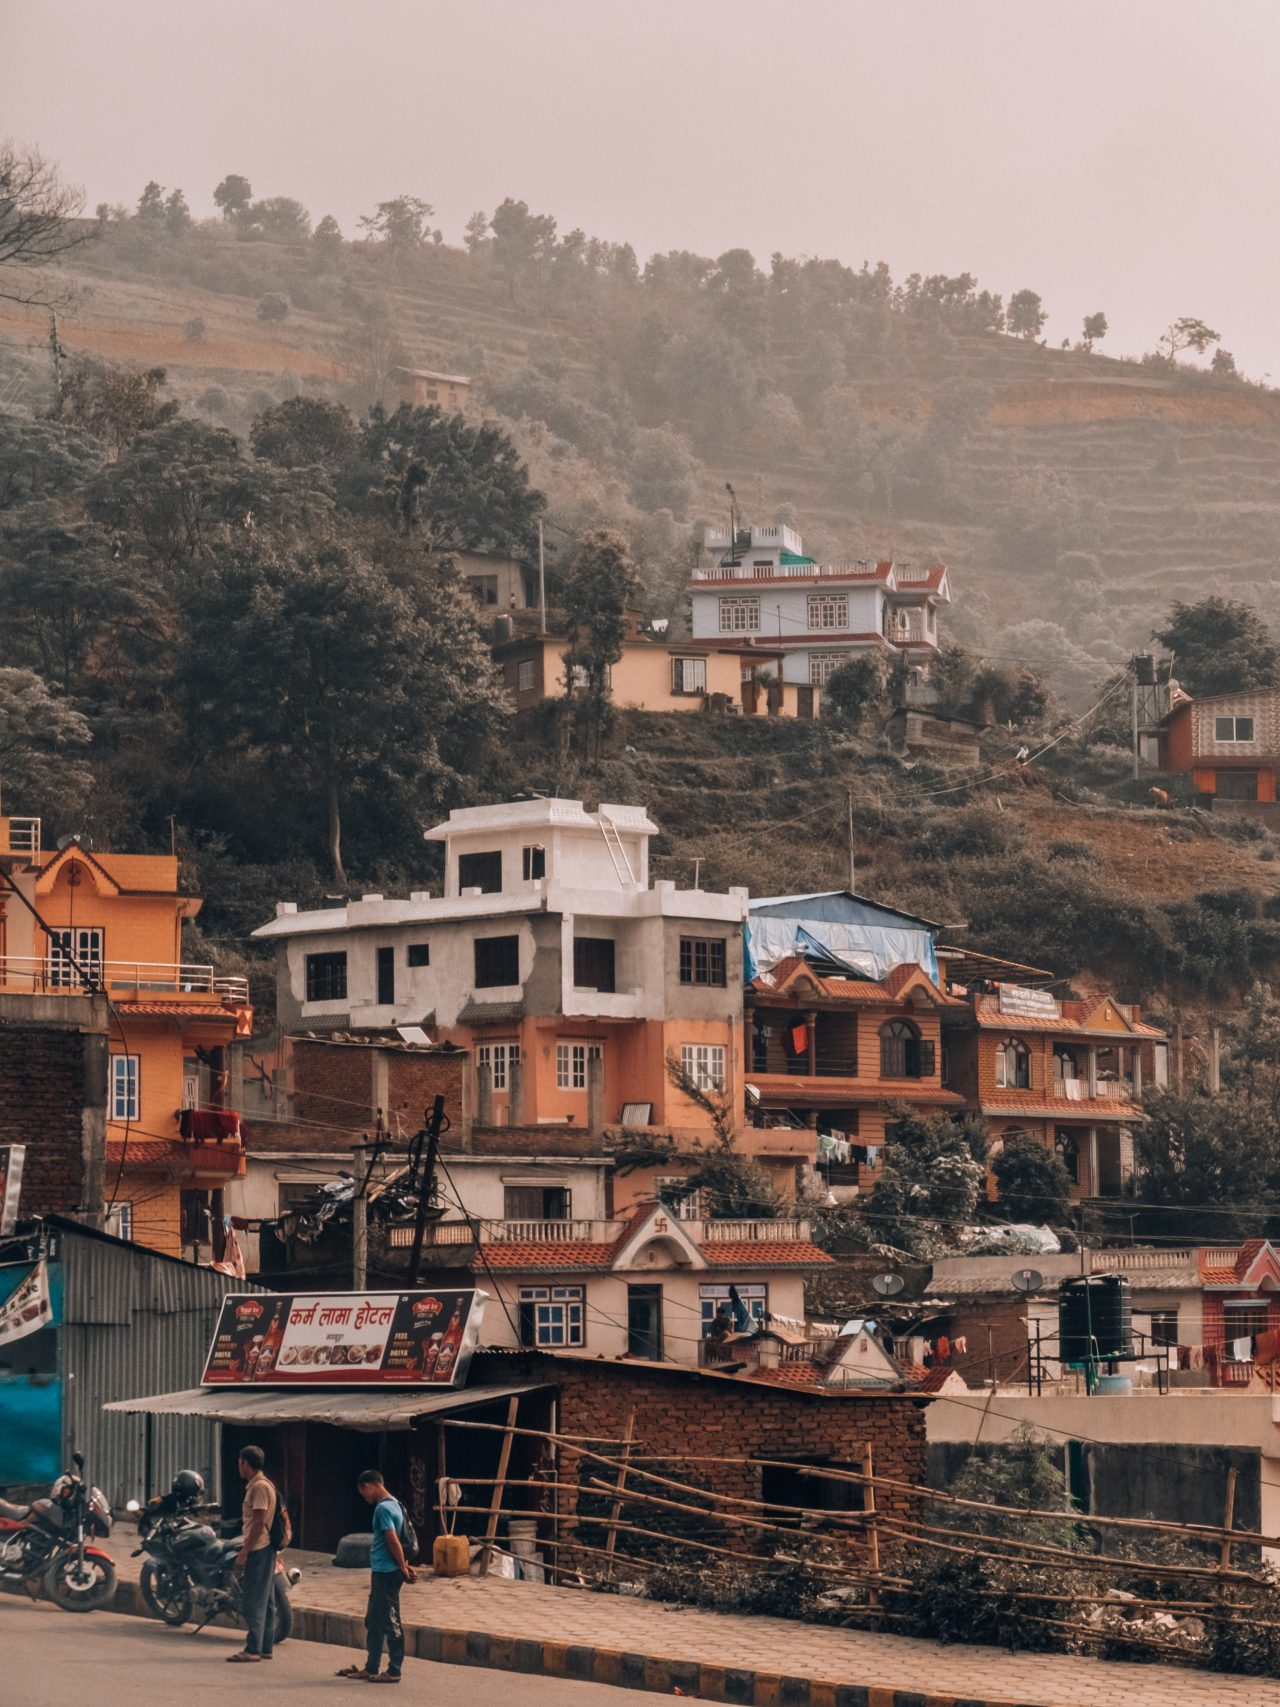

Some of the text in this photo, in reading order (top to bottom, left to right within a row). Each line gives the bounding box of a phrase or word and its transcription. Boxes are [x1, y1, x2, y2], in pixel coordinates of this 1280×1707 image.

[290, 1301, 395, 1330] कर्म लामा होटल
